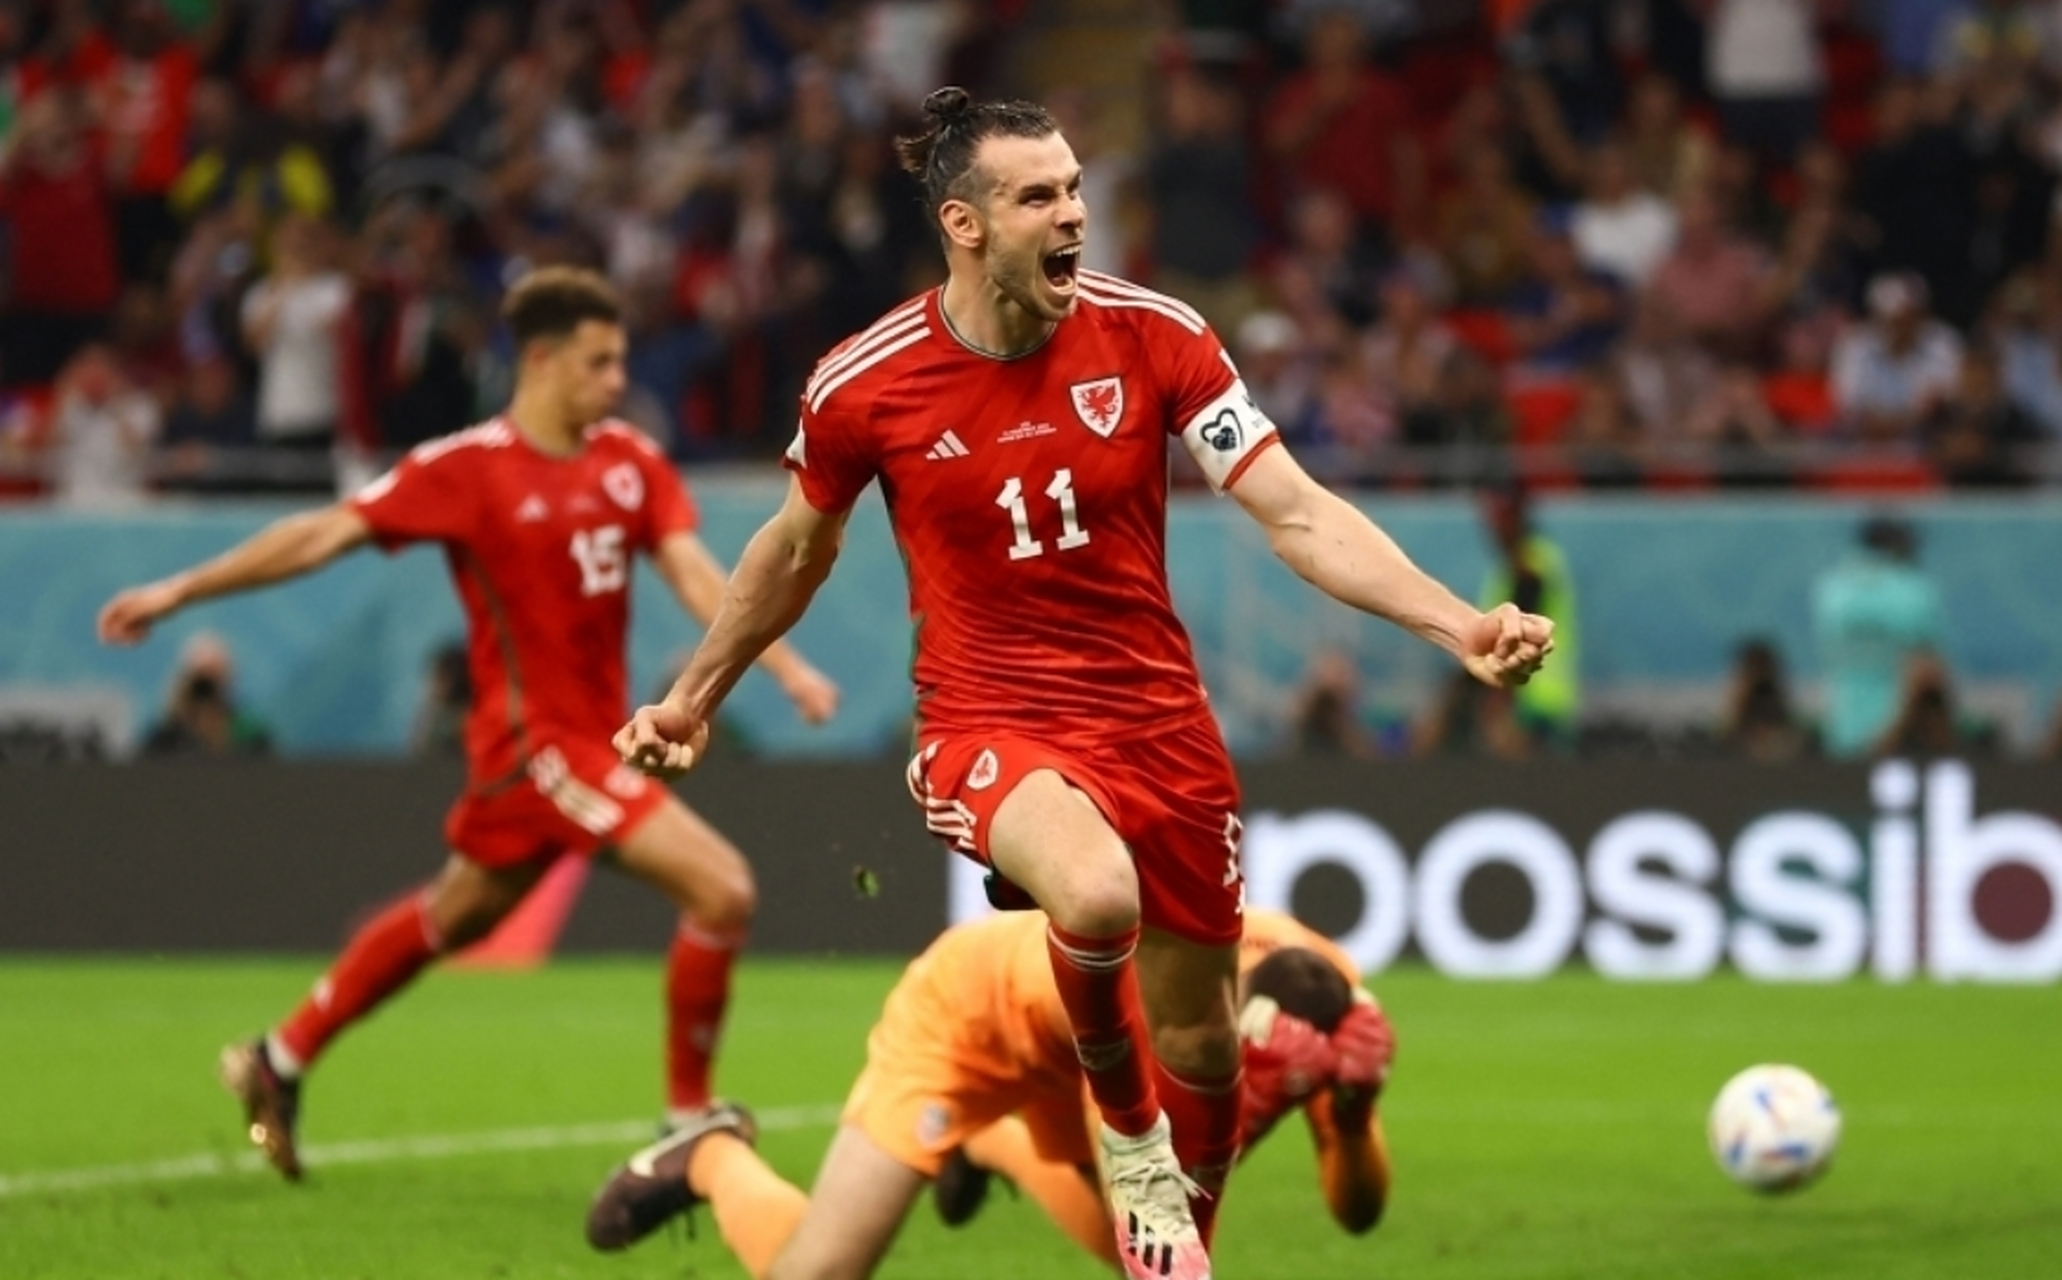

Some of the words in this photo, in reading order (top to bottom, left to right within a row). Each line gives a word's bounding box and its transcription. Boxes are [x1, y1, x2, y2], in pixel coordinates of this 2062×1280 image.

[995, 467, 1090, 560] 11
[570, 525, 625, 598] 15
[948, 758, 2062, 983] possib
